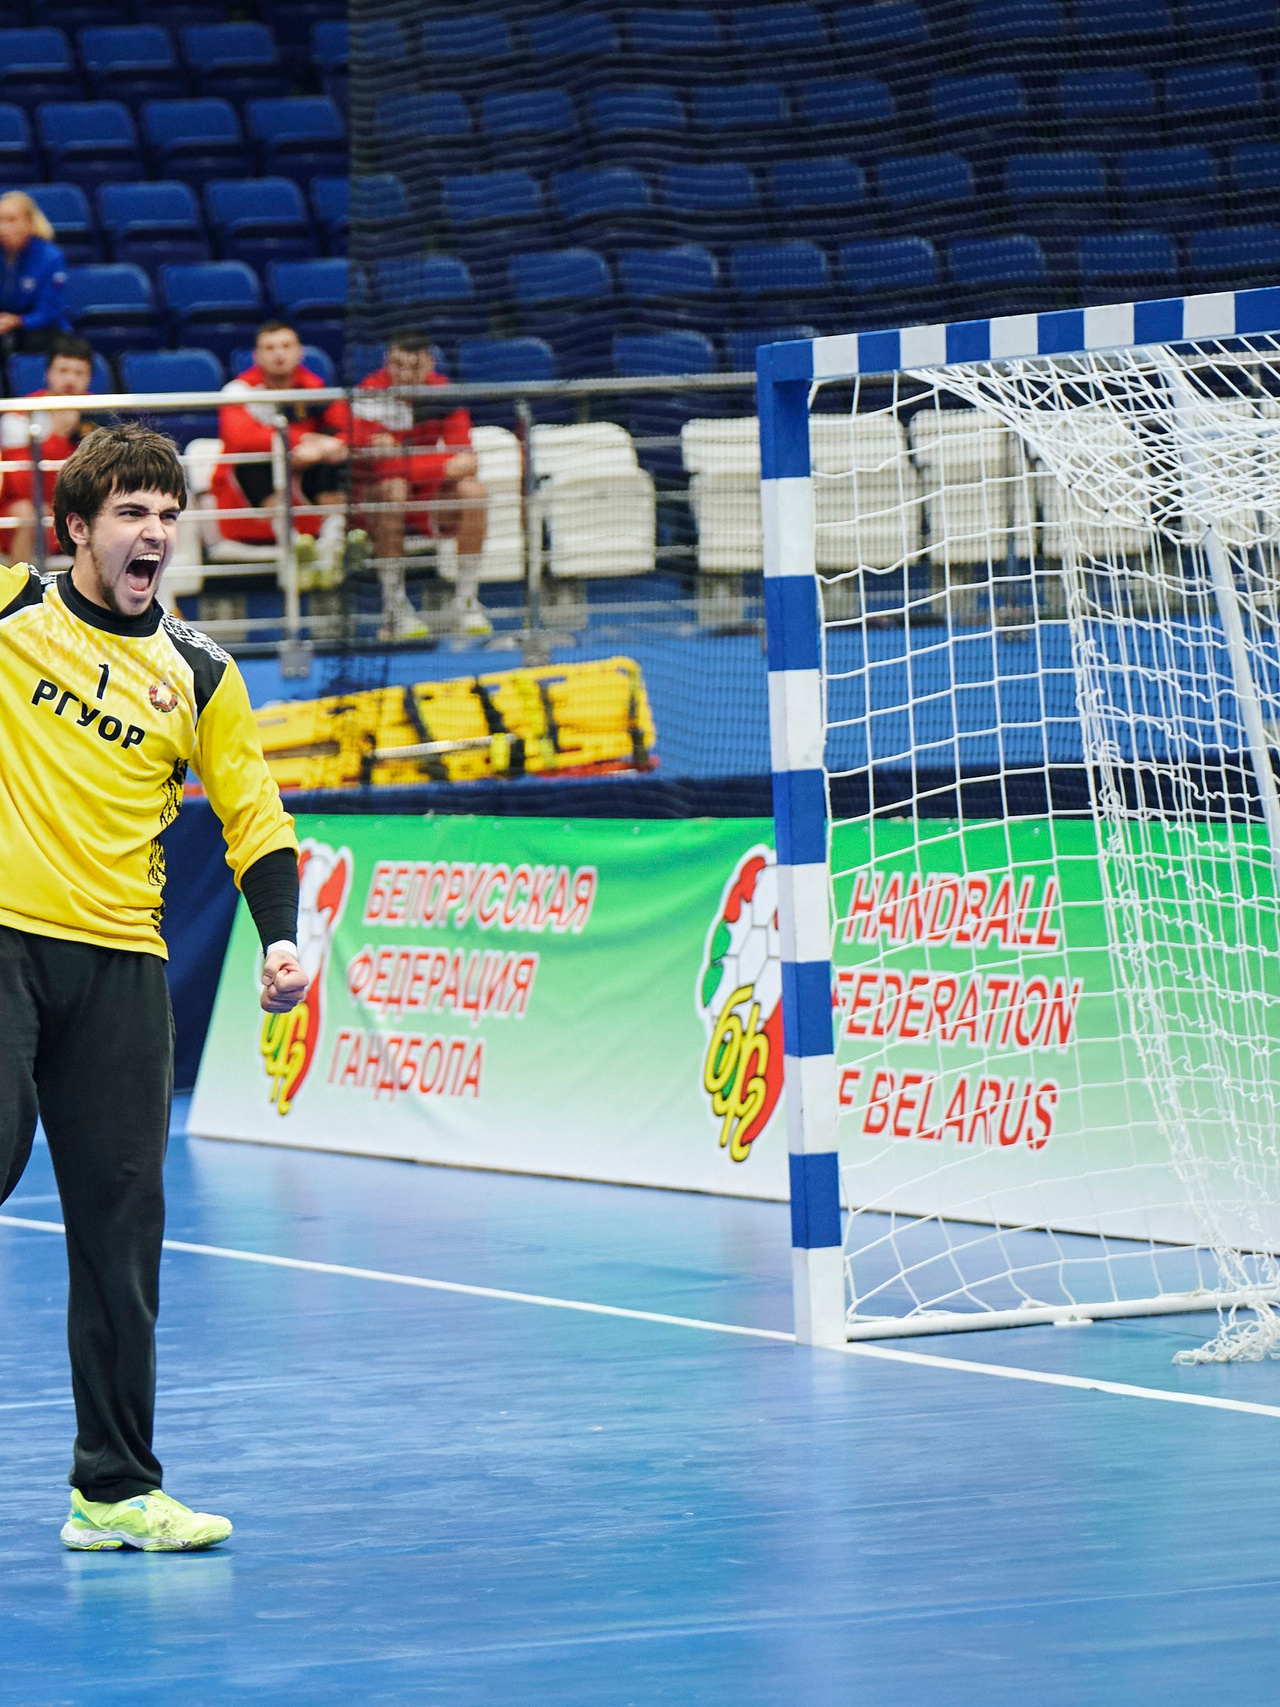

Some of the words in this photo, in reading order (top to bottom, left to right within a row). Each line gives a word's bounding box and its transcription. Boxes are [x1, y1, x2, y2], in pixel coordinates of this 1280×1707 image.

[31, 678, 147, 750] РГУОР
[97, 663, 110, 700] 1
[365, 865, 596, 932] БЕЛОРУССКАЯ
[844, 874, 1061, 948] HANDBALL
[348, 951, 538, 1022] ФЕДЕРАЦИЯ
[831, 972, 1082, 1050] FEDERATION
[328, 1031, 484, 1101] ГАНДБОЛА
[862, 1071, 1060, 1151] BELARUS
